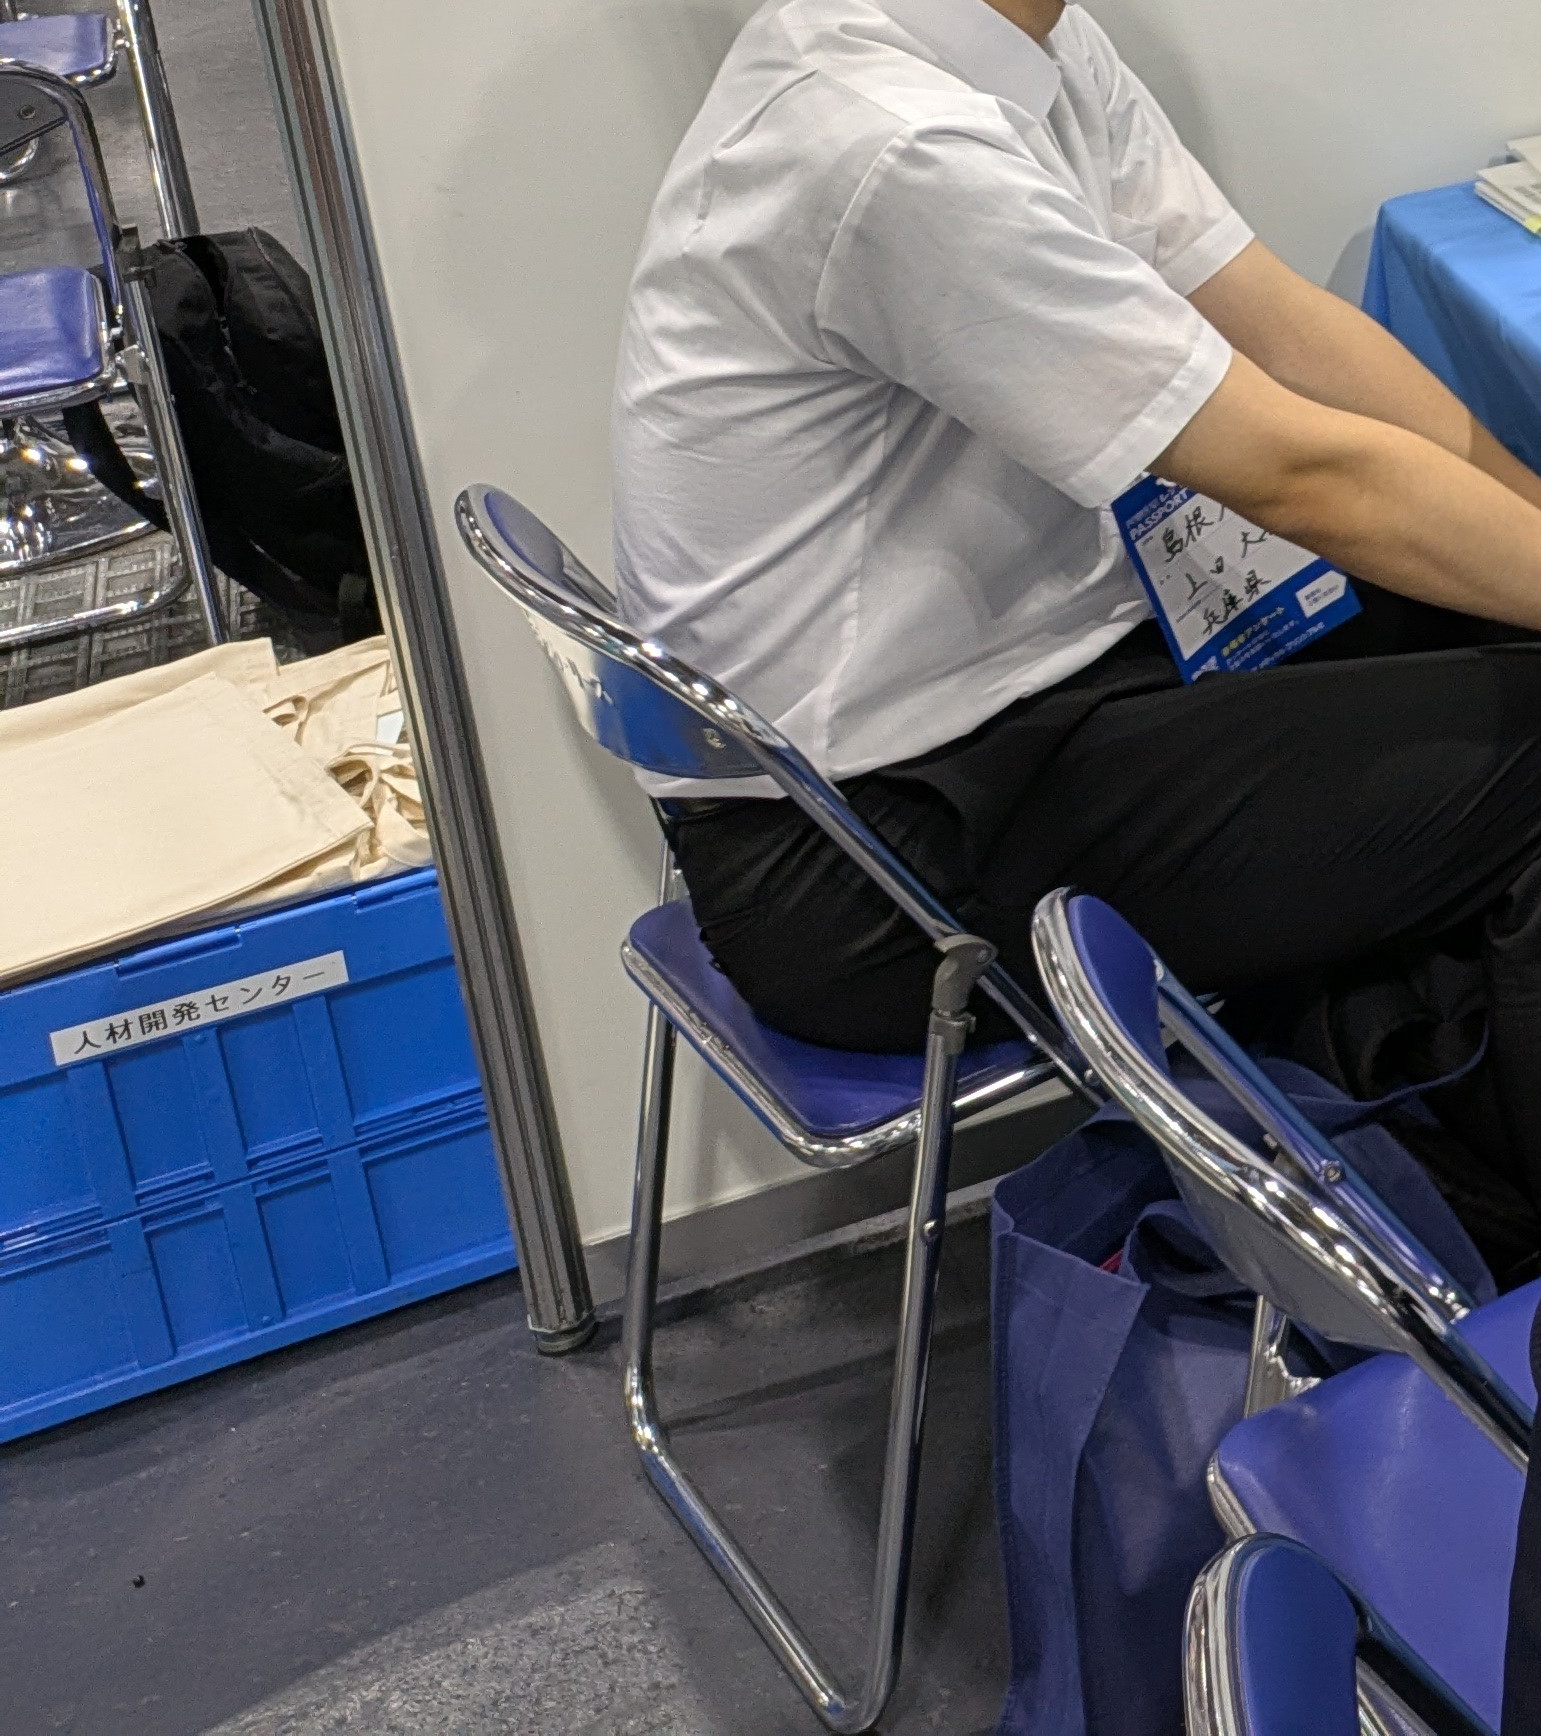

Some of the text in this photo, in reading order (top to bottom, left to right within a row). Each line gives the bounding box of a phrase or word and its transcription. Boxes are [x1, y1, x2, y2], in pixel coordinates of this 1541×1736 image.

[1129, 488, 1190, 541] PASSPORT
[1162, 503, 1225, 562] 島根
[74, 971, 325, 1054] 人材開発センター
